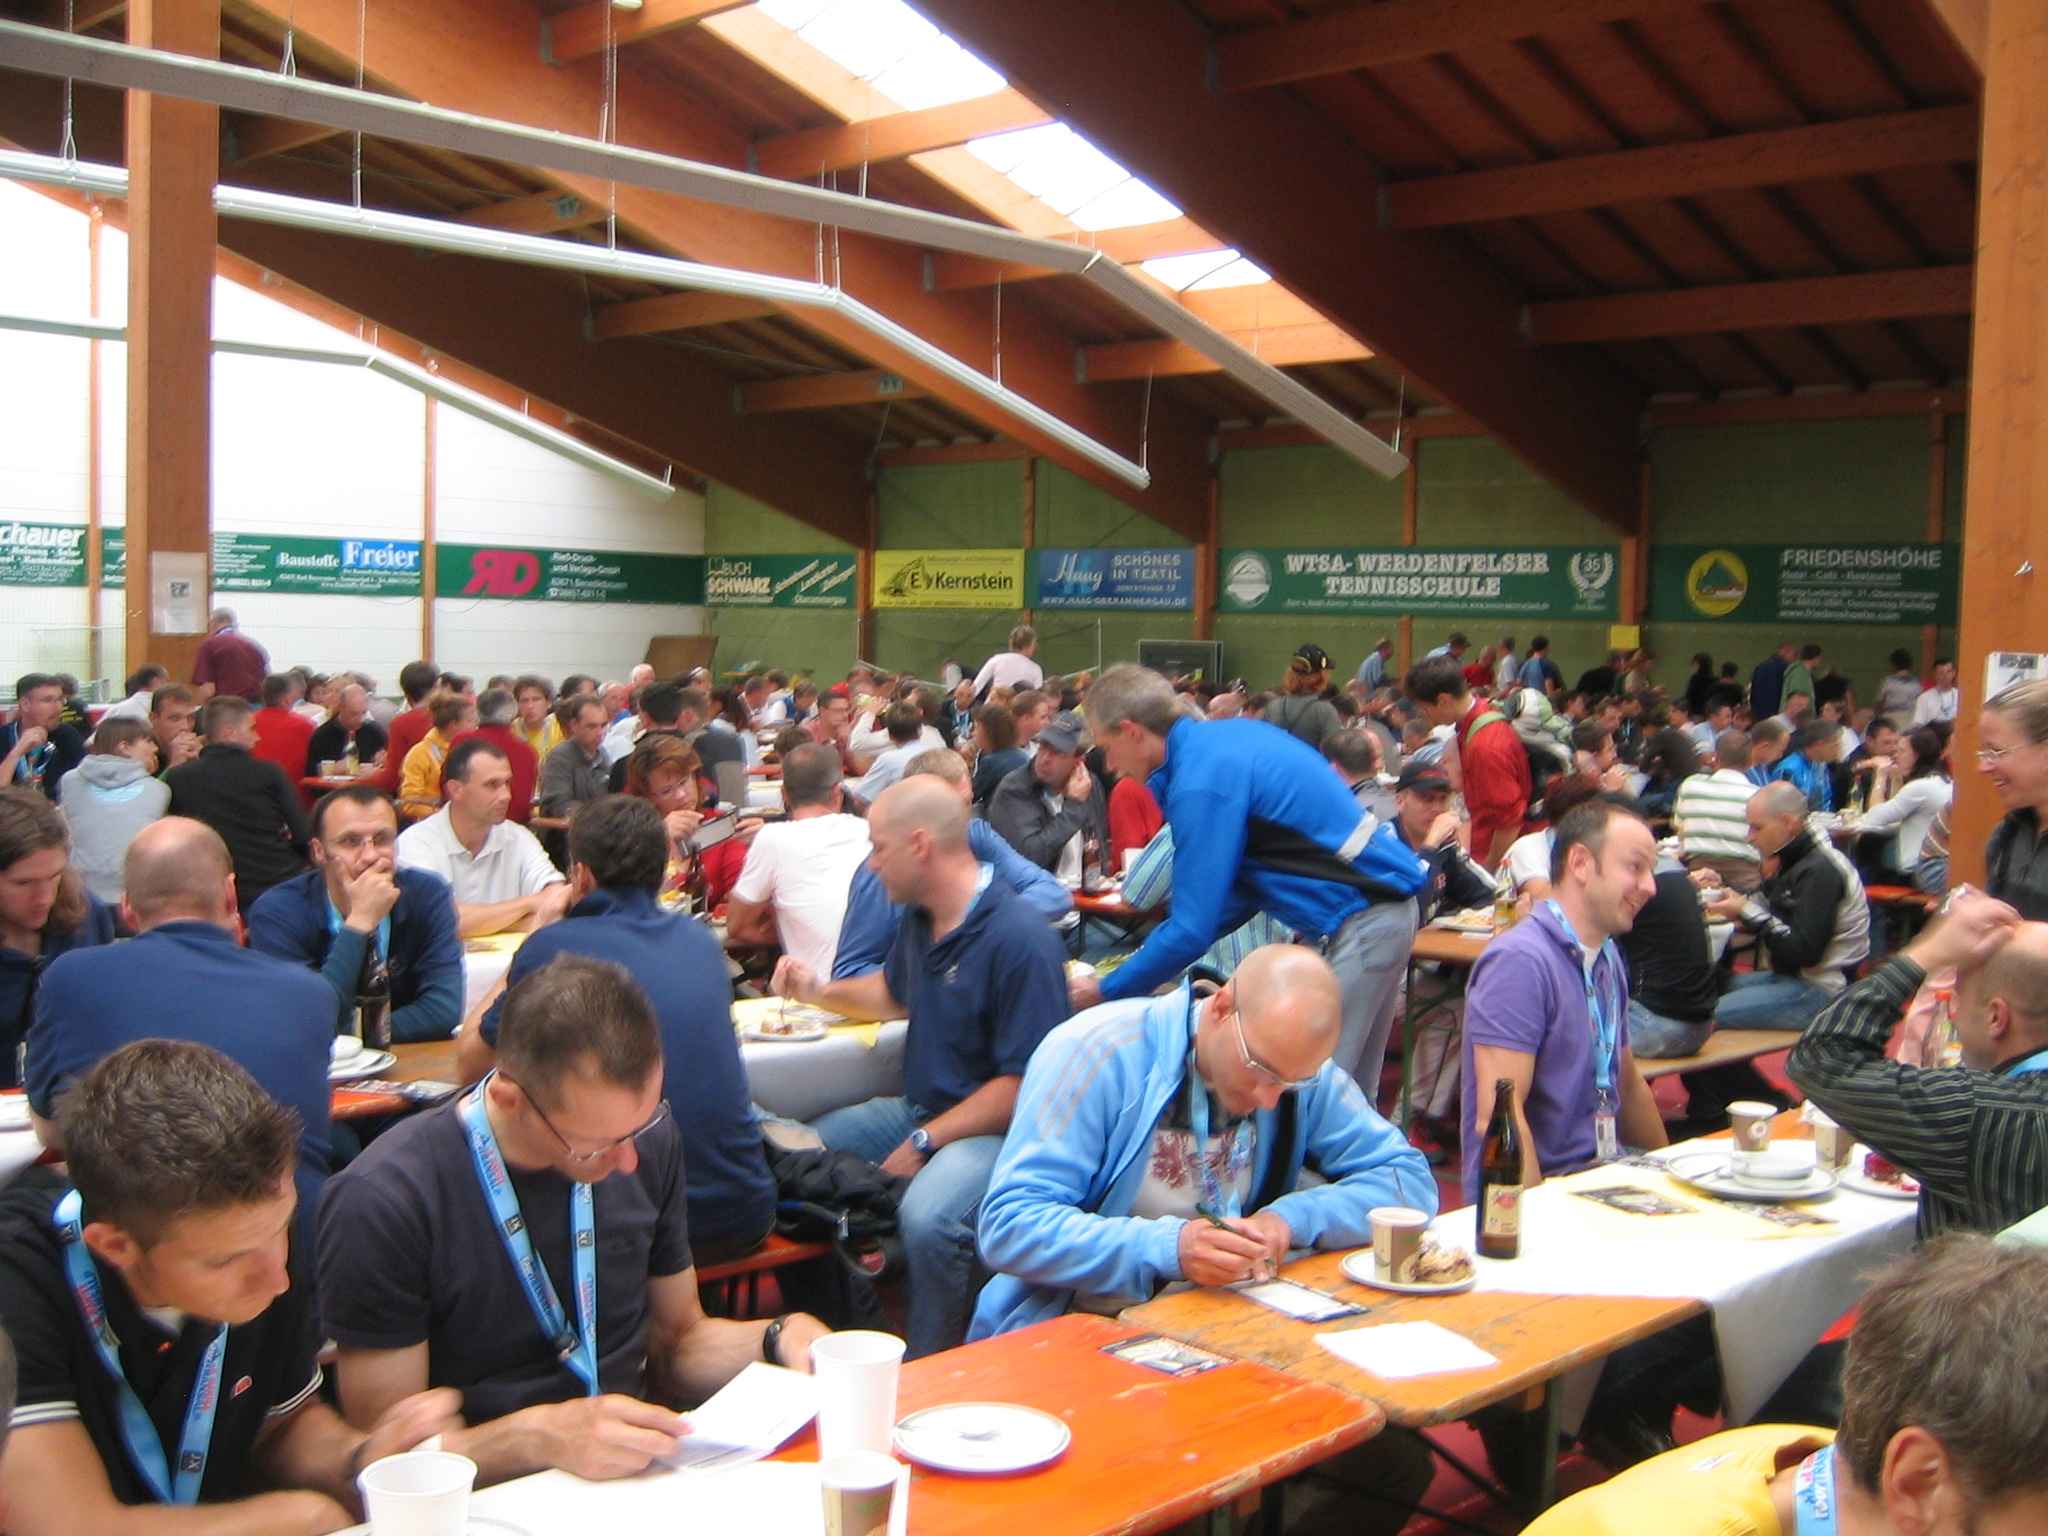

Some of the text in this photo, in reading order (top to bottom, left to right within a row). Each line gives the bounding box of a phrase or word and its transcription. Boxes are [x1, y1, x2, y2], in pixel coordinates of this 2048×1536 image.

[278, 551, 340, 568] Baustoffe
[342, 541, 419, 569] Freier
[1112, 552, 1182, 567] SCHÖNES
[1284, 552, 1551, 575] WTSA- WERDENFELSER
[1781, 547, 1943, 568] FRIEDENSHÖHE
[707, 575, 771, 593] SCHWARZ
[935, 571, 1013, 590] Kernstein
[1112, 568, 1182, 581] IN TEXTIL
[1325, 575, 1502, 597] TENNISSCHULE
